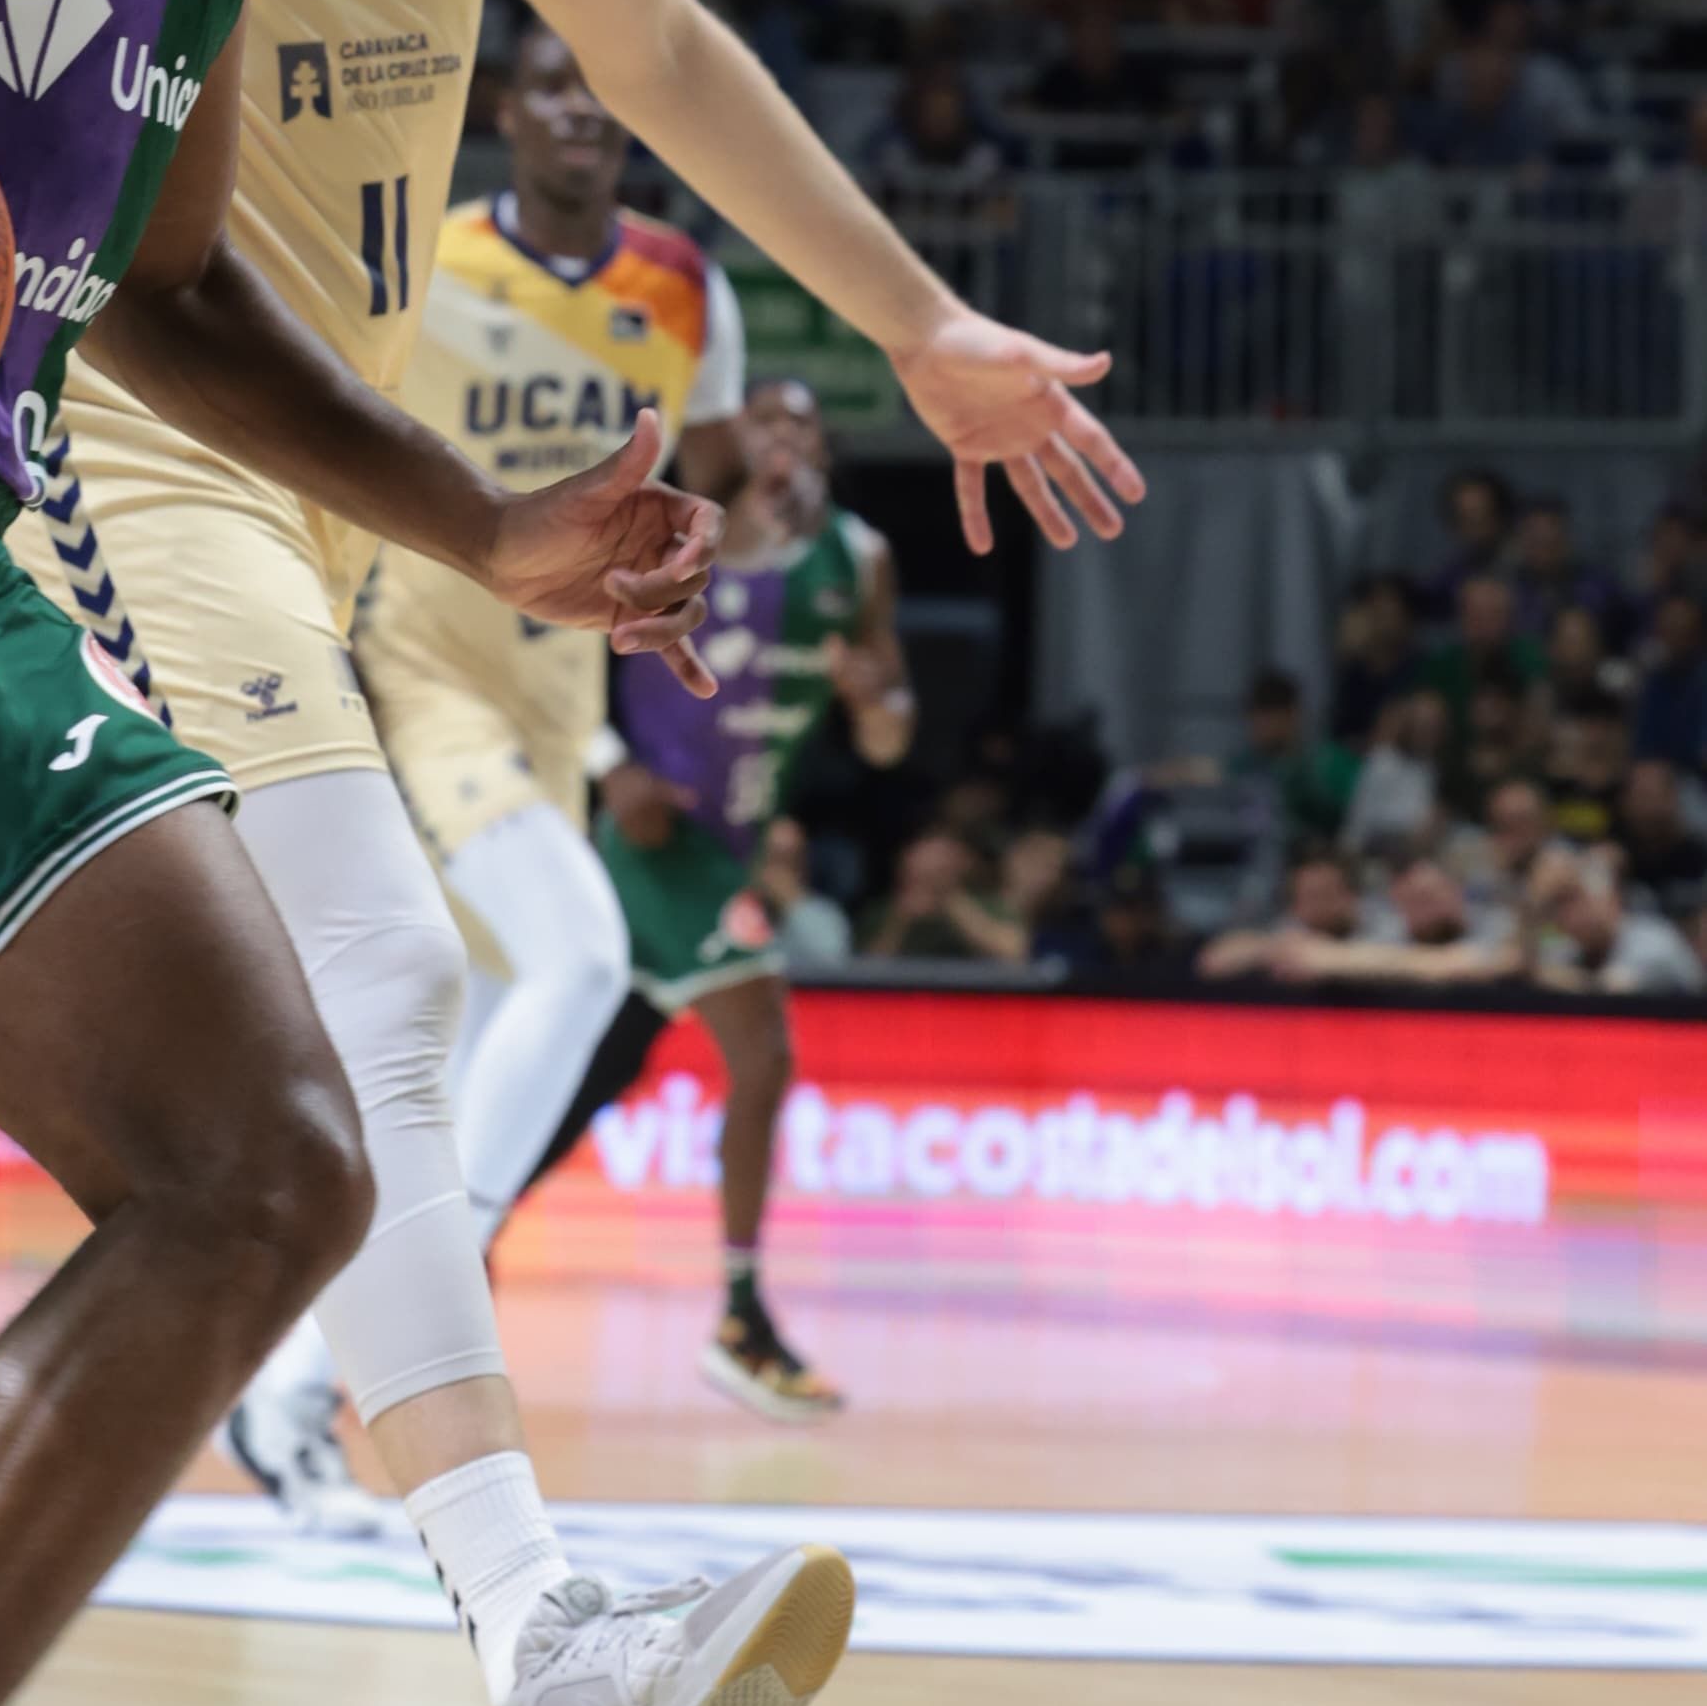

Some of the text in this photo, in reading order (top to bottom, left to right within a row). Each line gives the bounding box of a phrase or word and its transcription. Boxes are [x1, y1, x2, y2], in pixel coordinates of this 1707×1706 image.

[111, 36, 202, 132] Unic
[339, 32, 430, 60] CARAVACA
[361, 174, 409, 317] 11
[591, 1070, 1550, 1225] vitacostadelsol.com
